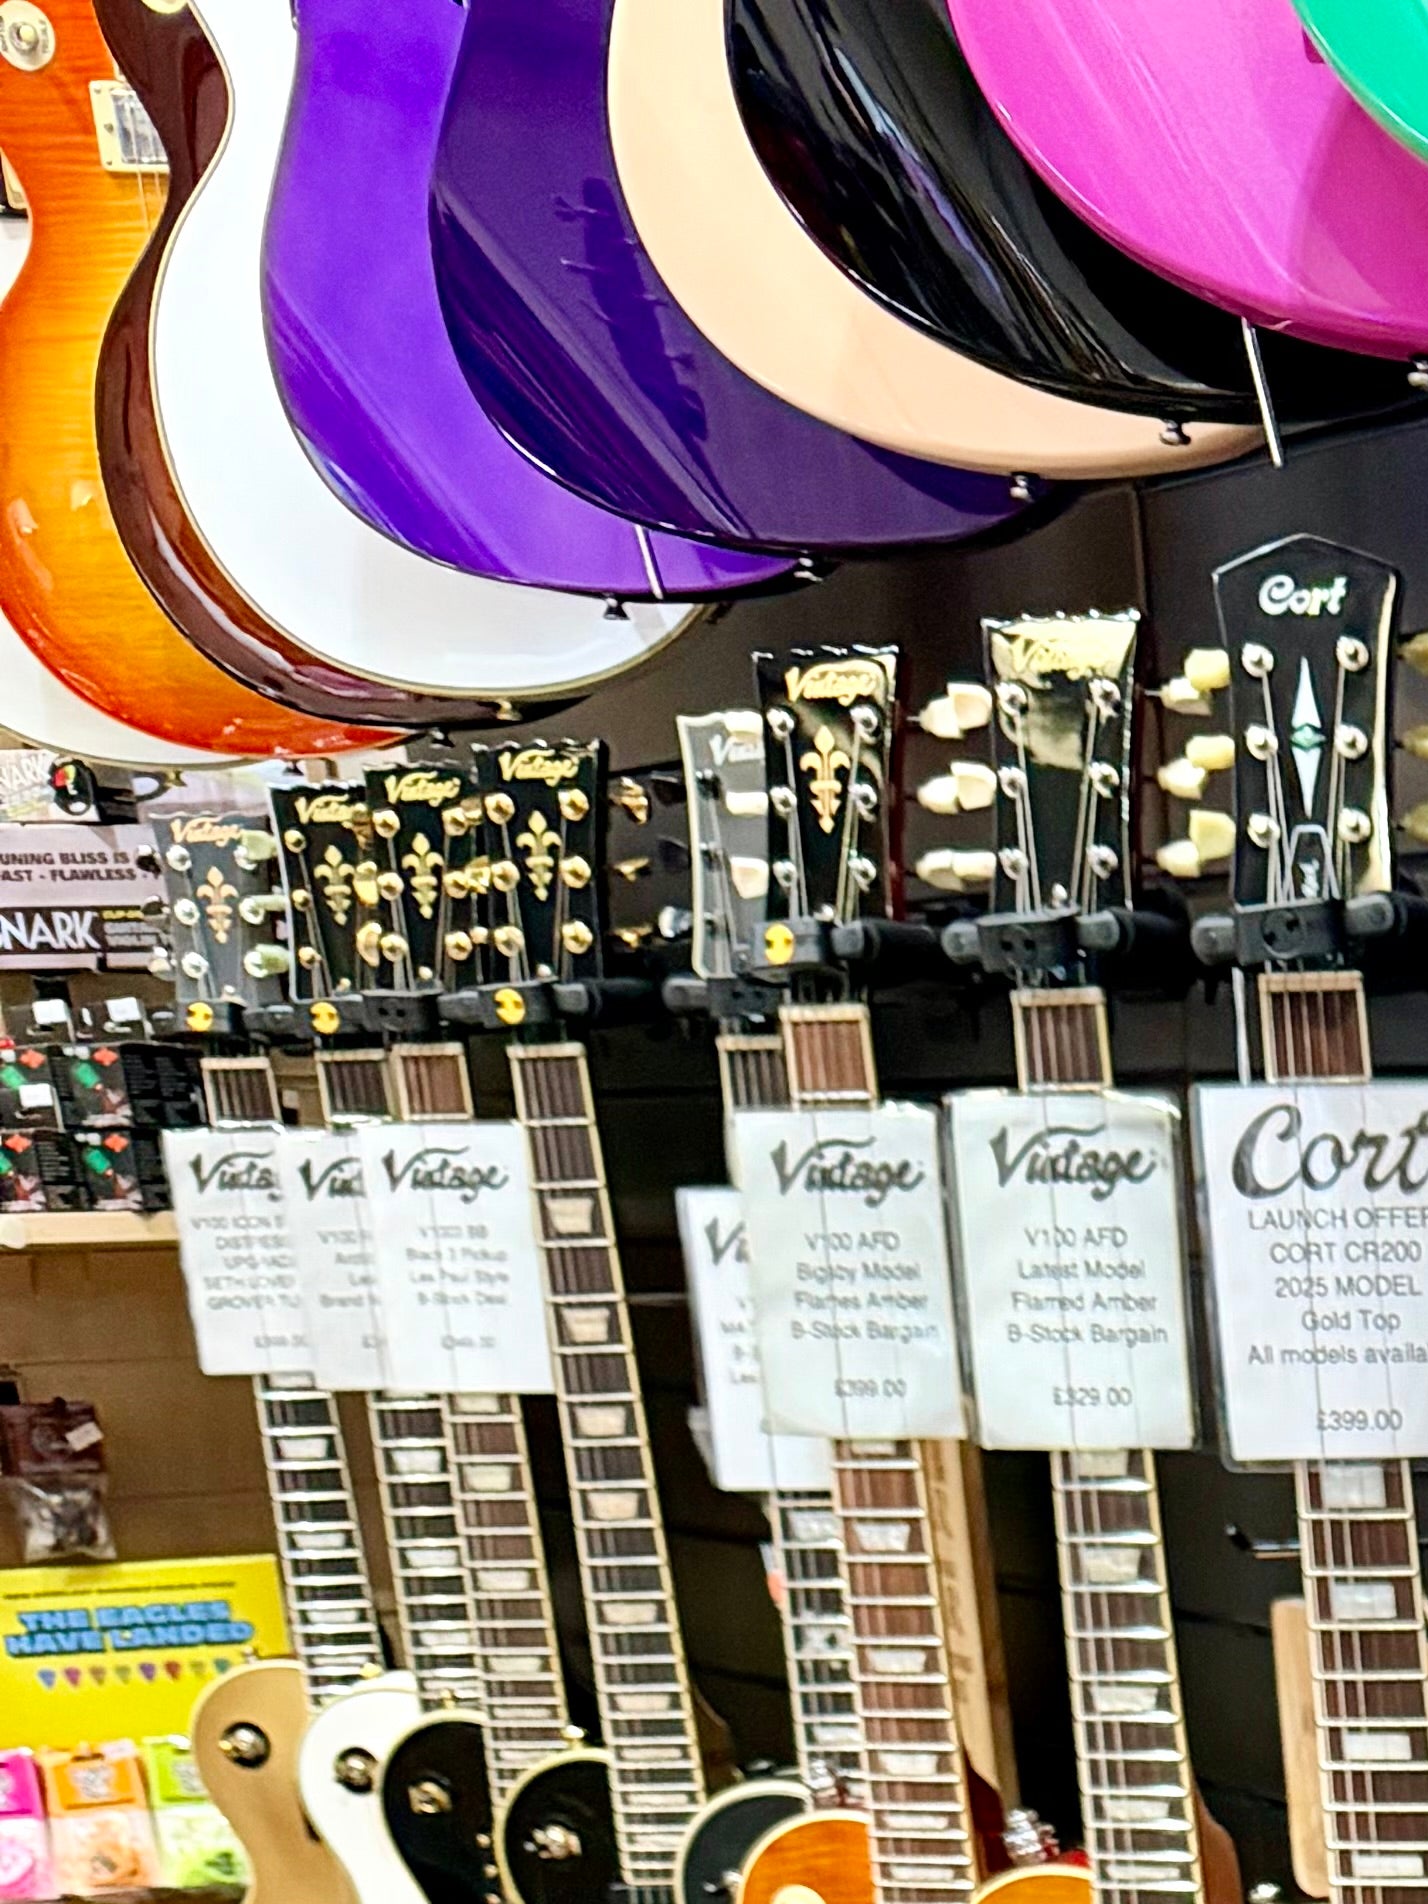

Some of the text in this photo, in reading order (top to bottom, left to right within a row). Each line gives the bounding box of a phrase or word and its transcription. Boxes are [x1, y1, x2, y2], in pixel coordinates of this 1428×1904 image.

[1259, 575, 1348, 615] Cort
[499, 749, 580, 788] Vintage
[384, 772, 462, 806] Vintage
[59, 852, 130, 864] BLISS IS
[51, 869, 137, 881] FLAWLESS
[770, 1137, 924, 1206] Vintage
[989, 1125, 1157, 1200] Vintage
[382, 1146, 509, 1203] Vintage
[1248, 1208, 1347, 1230] LAUNCH
[858, 1231, 900, 1251] AFD
[1025, 1227, 1128, 1248] V100 AFD
[1270, 1242, 1422, 1264] CORT CR200
[864, 1263, 920, 1282] Model
[1018, 1259, 1145, 1280] Latest Model
[1275, 1276, 1422, 1298] 2025 MODEL
[856, 1292, 928, 1311] Amber
[1011, 1292, 1157, 1313] Flamed Amber
[791, 1321, 939, 1344] B-Stock Bargain
[1301, 1311, 1400, 1332] Gold Top
[1008, 1323, 1168, 1348] B-Stock Bargain
[1248, 1346, 1275, 1365] All
[1281, 1346, 1358, 1365] models
[1316, 1410, 1403, 1431] £399.00
[18, 1601, 230, 1631] THE EAGLES
[5, 1622, 254, 1656] HAVE LANDED
